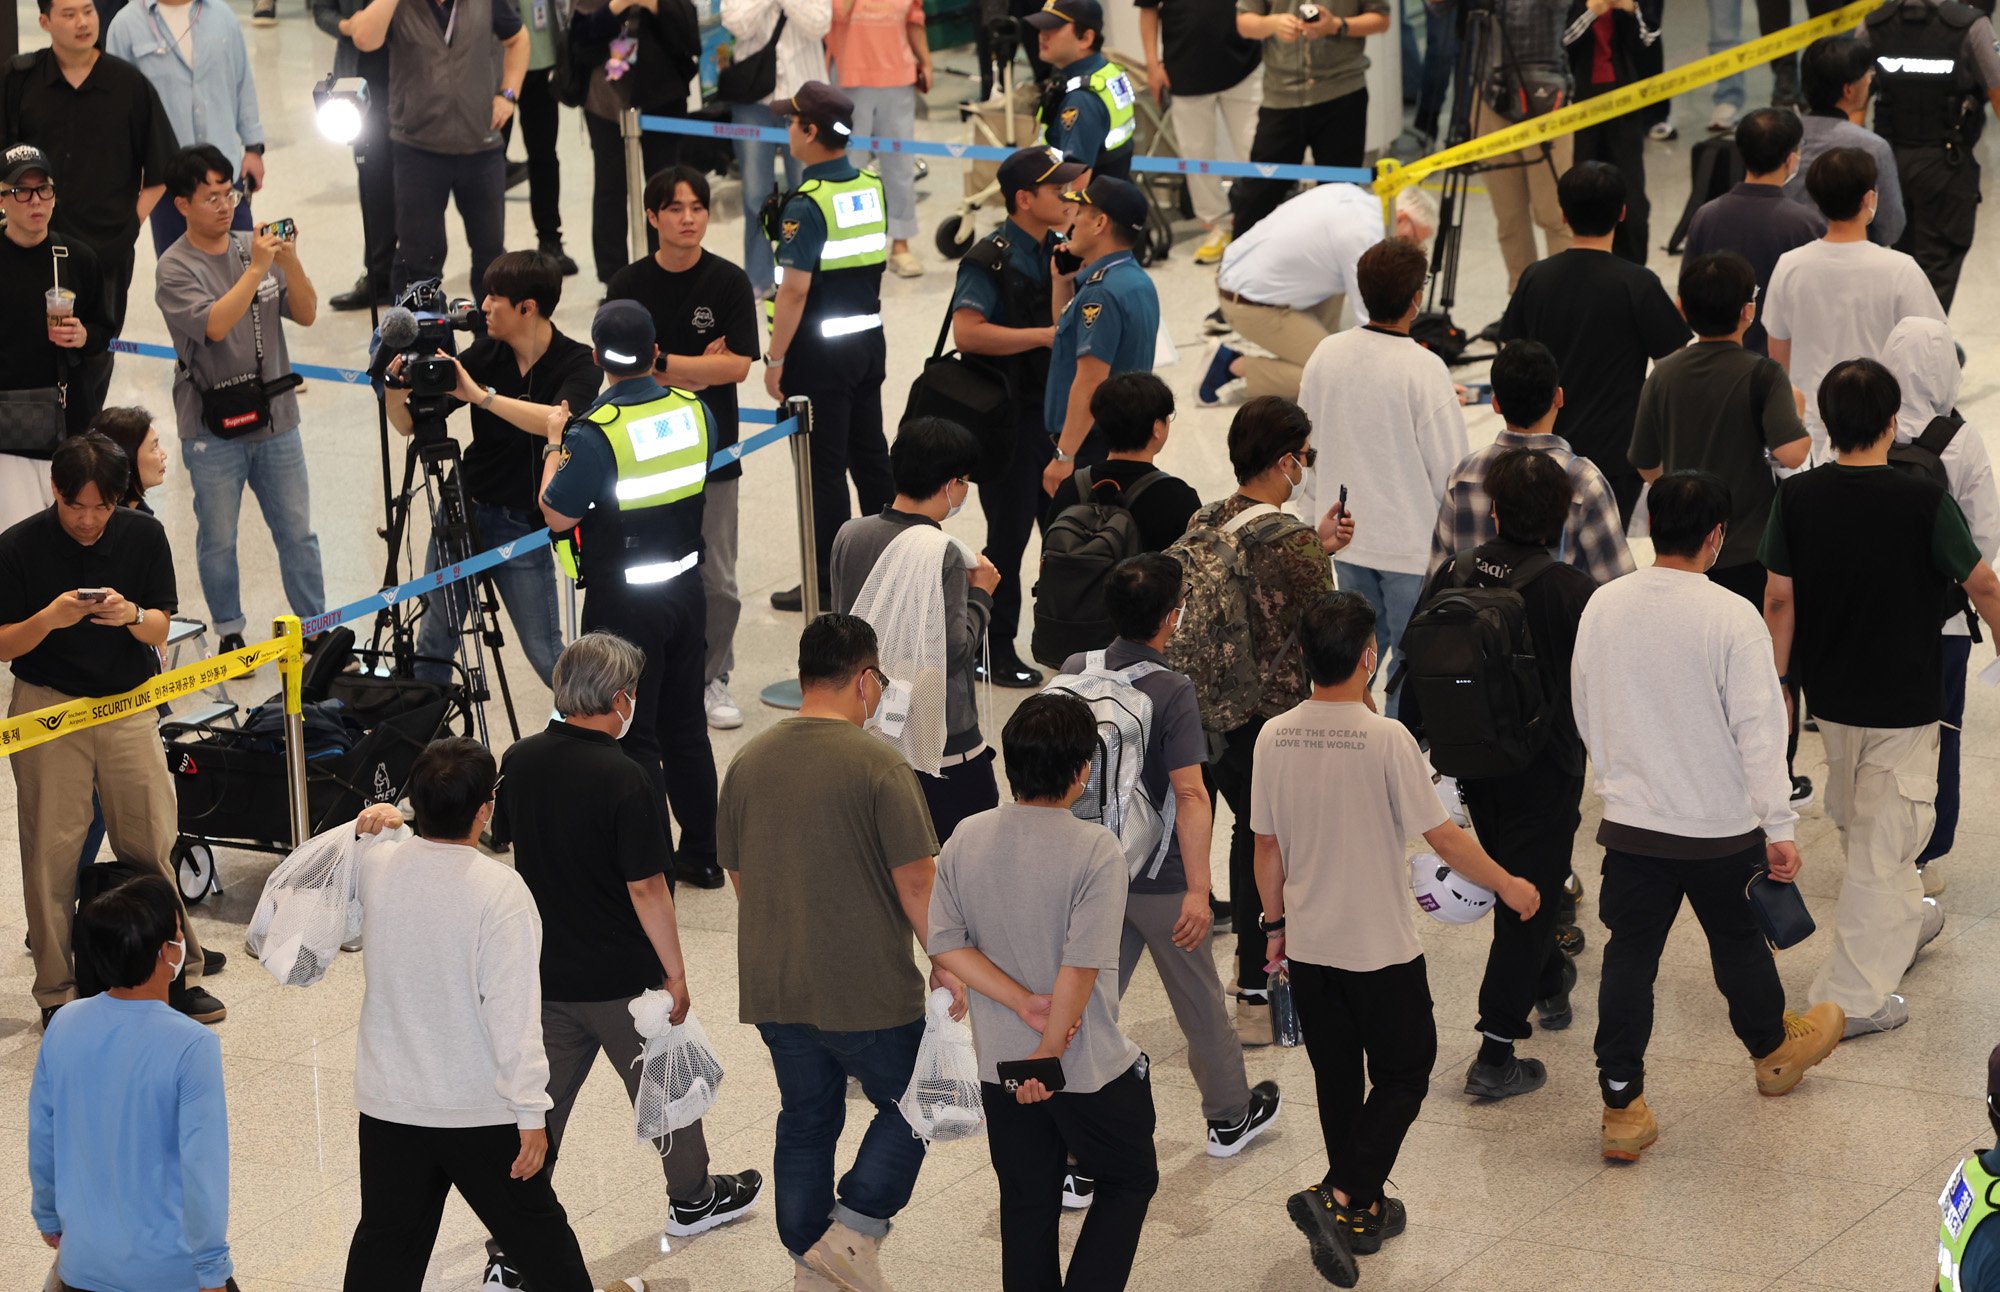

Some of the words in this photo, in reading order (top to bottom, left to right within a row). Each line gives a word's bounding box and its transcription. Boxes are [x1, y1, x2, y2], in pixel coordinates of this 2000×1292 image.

[225, 413, 256, 427] Supreme
[301, 610, 342, 636] SECURITY
[154, 675, 196, 699] 인천국제공항
[200, 664, 227, 684] 보안통제
[92, 697, 132, 719] SECURITY
[135, 691, 152, 707] LINE
[67, 710, 88, 719] Incheon
[69, 717, 87, 726] Airport
[0, 727, 20, 746] 통제
[1276, 728, 1302, 736] LOVE
[1305, 729, 1325, 737] THE
[1328, 729, 1367, 739] OCEAN
[1275, 739, 1300, 748] LOVE
[1303, 740, 1324, 749] THE
[1326, 740, 1365, 750] WORLD
